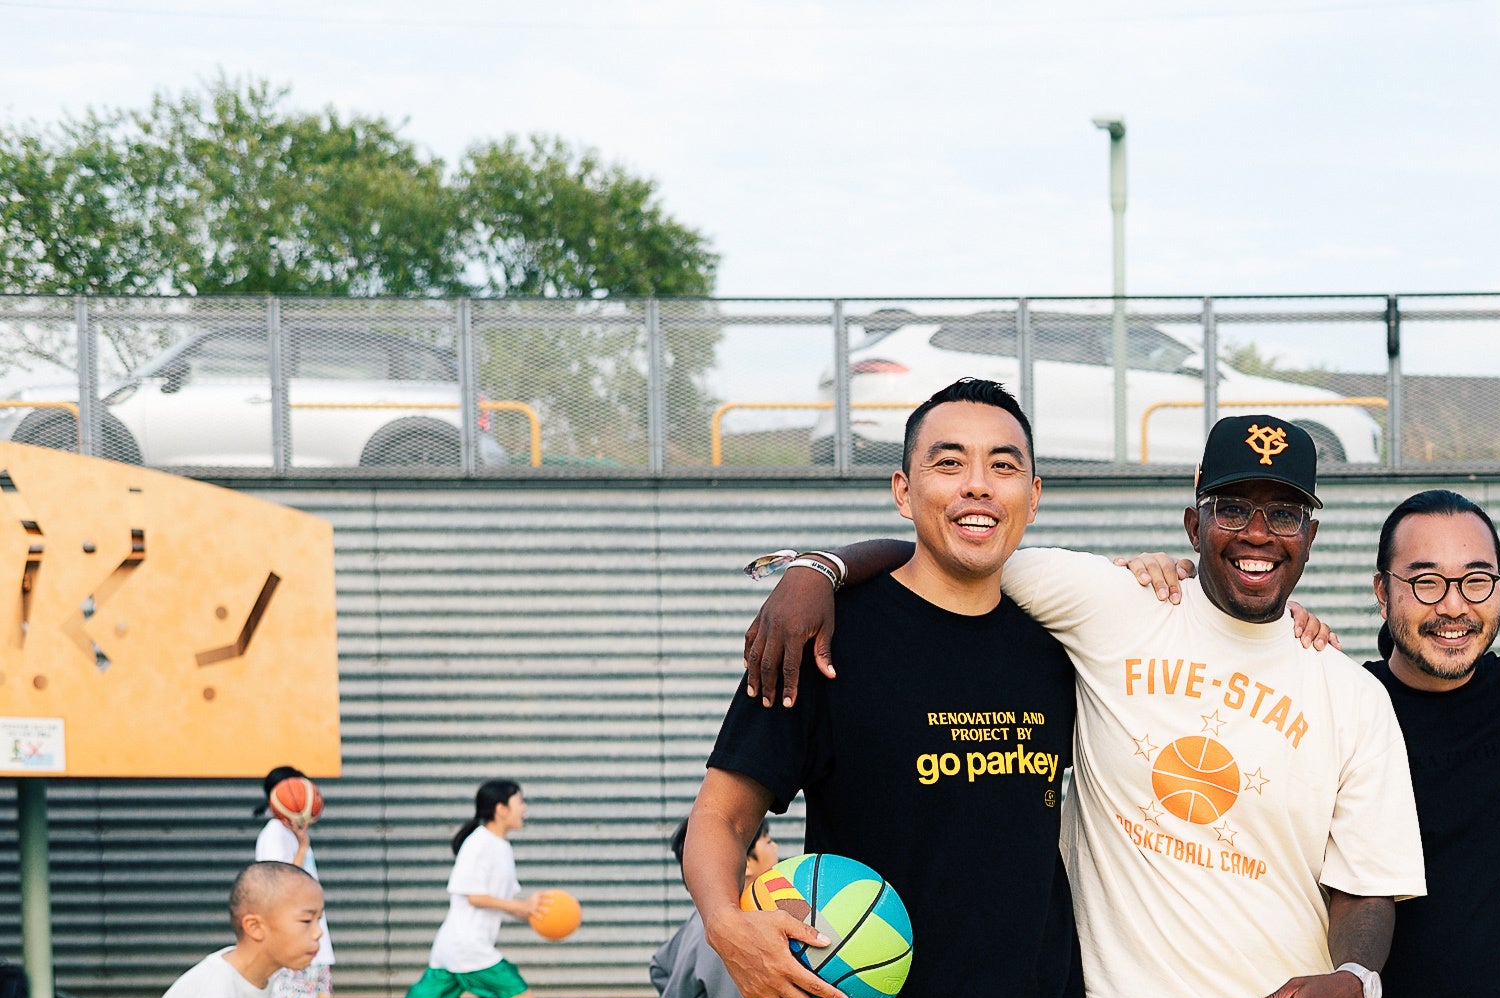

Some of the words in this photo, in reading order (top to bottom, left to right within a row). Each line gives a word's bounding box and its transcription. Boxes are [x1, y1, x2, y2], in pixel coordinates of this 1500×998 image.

[927, 711, 1016, 726] RENOVATION
[1022, 711, 1045, 725] AND
[1125, 658, 1309, 750] FIVE-STAR
[951, 727, 1009, 742] PROJECT
[1016, 727, 1033, 741] BY
[916, 752, 961, 785] go
[966, 743, 1059, 783] parkey
[1220, 850, 1267, 881] CAMP
